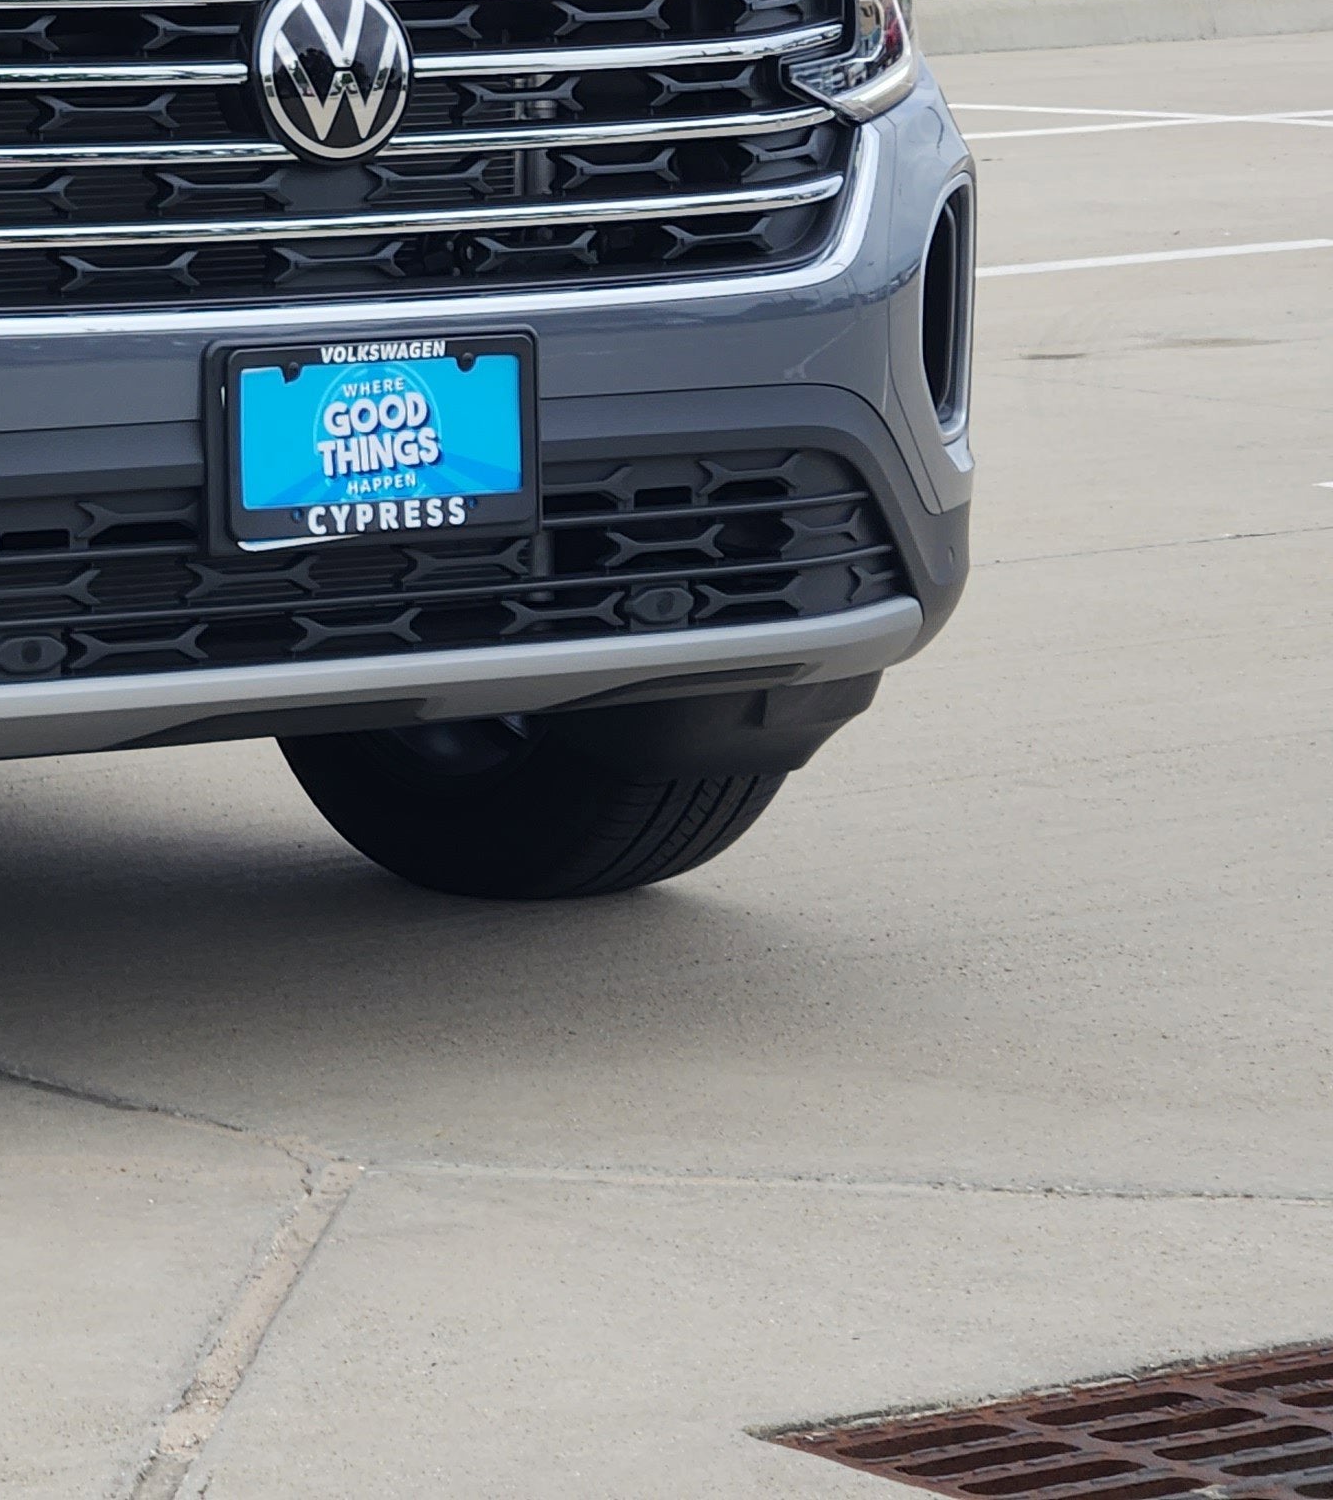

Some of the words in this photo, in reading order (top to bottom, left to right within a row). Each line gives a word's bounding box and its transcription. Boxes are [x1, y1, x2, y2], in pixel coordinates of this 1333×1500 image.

[320, 340, 446, 364] VOLKSWAGEN
[341, 376, 405, 398] WHERE
[322, 391, 428, 437] GOOD
[316, 426, 442, 477] THINGS
[346, 473, 417, 496] HAPPEN
[307, 496, 467, 535] CYPRESS
